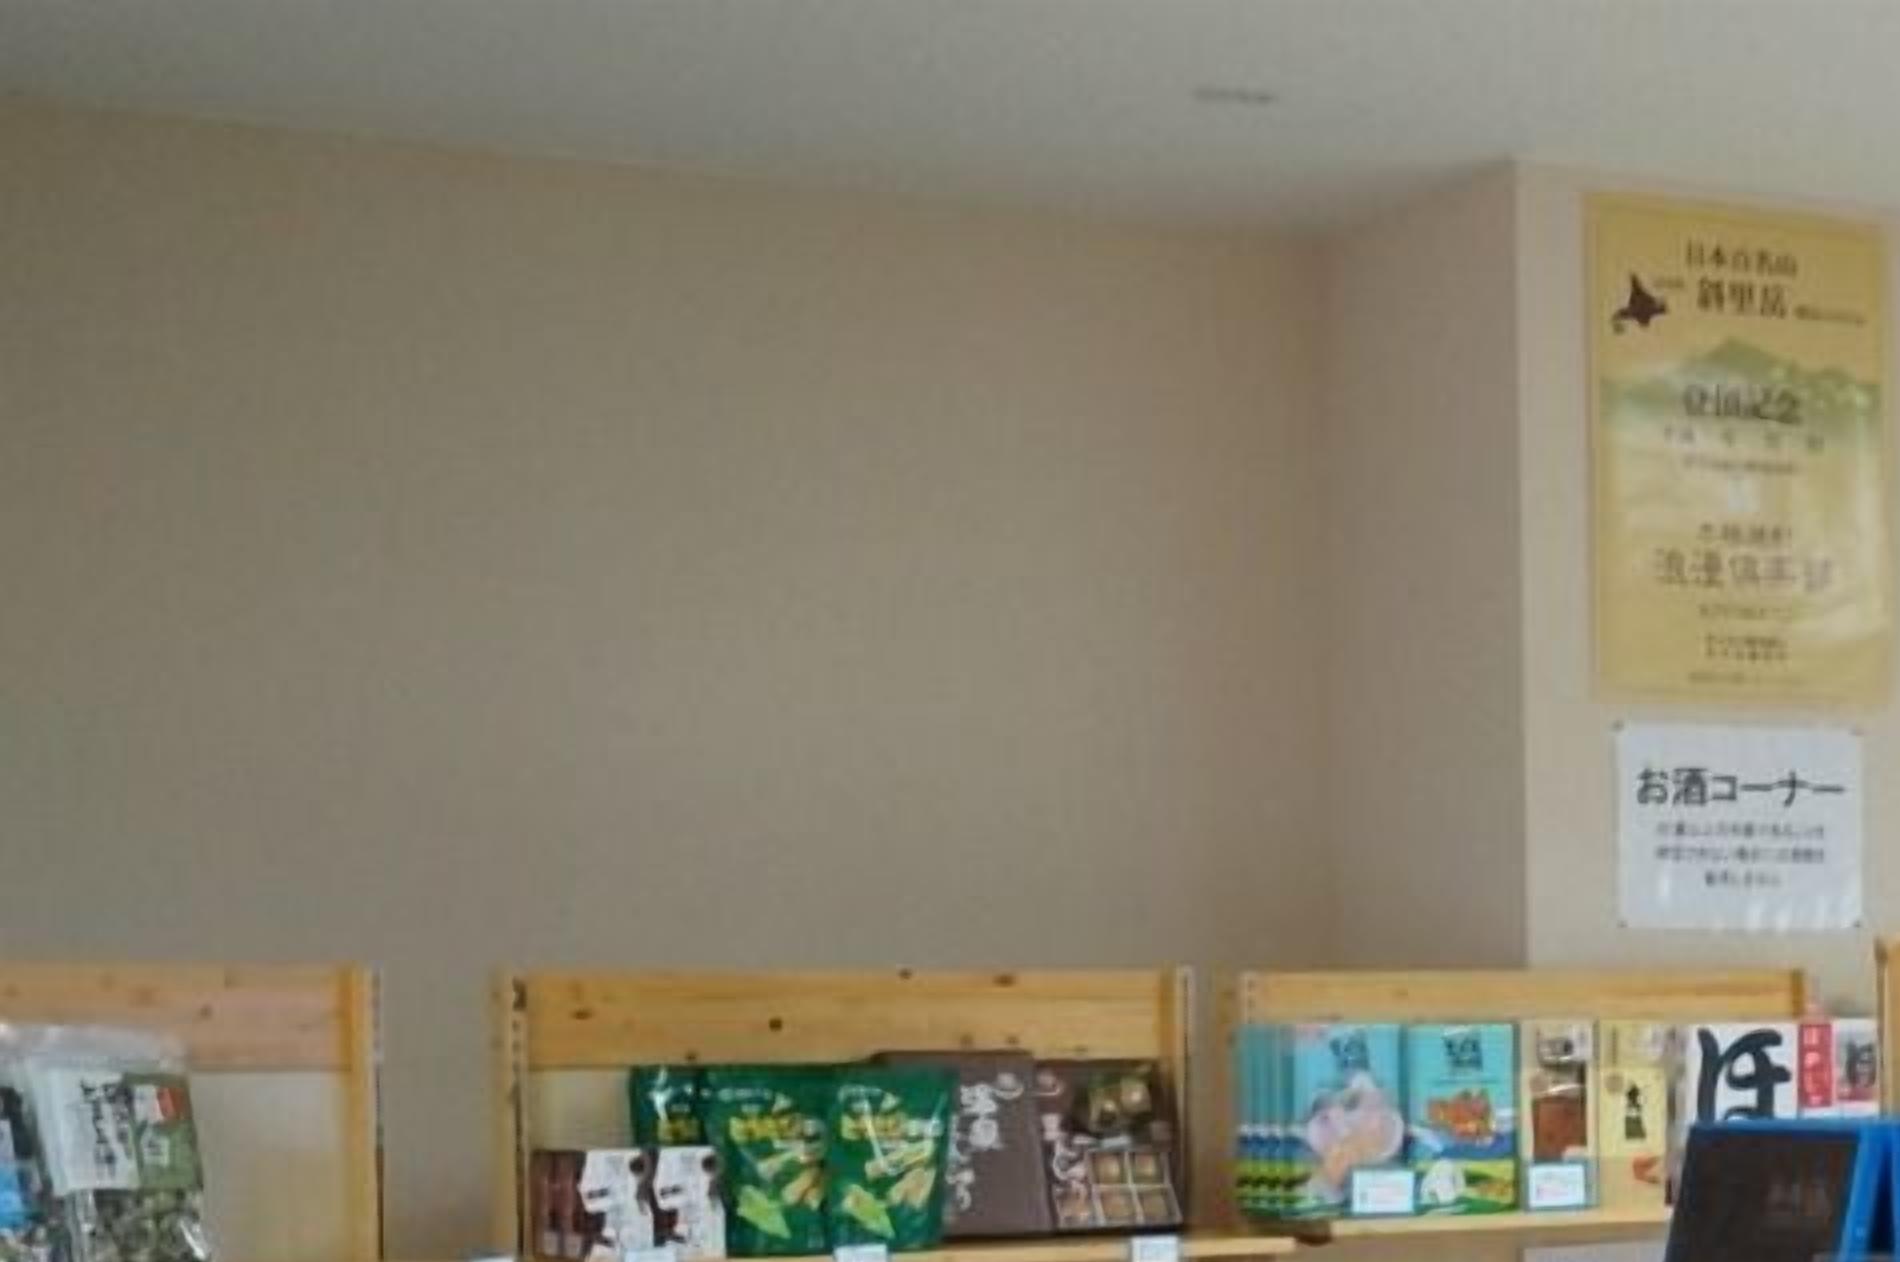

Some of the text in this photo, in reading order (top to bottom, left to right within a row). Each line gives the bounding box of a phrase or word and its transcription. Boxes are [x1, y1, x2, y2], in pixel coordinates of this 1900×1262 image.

[1637, 767, 1845, 807] お酒コーナー
